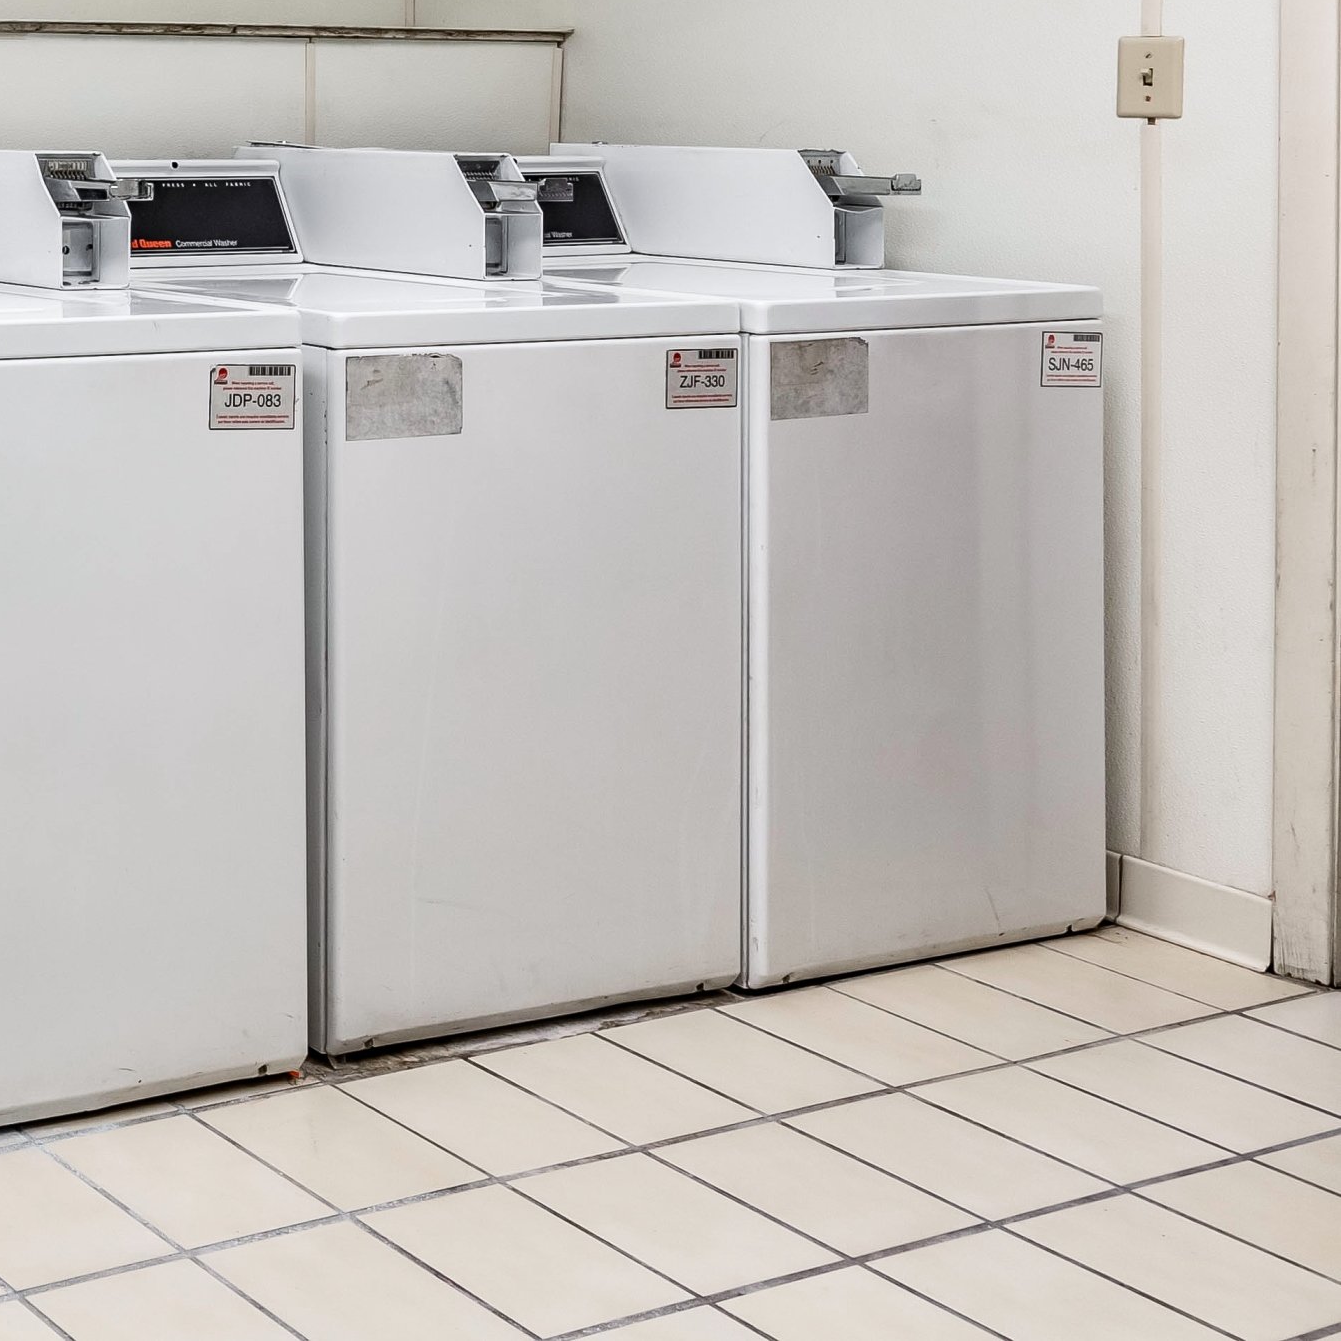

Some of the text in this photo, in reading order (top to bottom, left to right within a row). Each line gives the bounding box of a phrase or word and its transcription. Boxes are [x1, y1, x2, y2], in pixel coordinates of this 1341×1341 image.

[139, 239, 172, 248] Queen
[1048, 357, 1093, 371] SJN-465
[680, 375, 725, 388] ZJF-330
[225, 394, 281, 407] JDP-083
